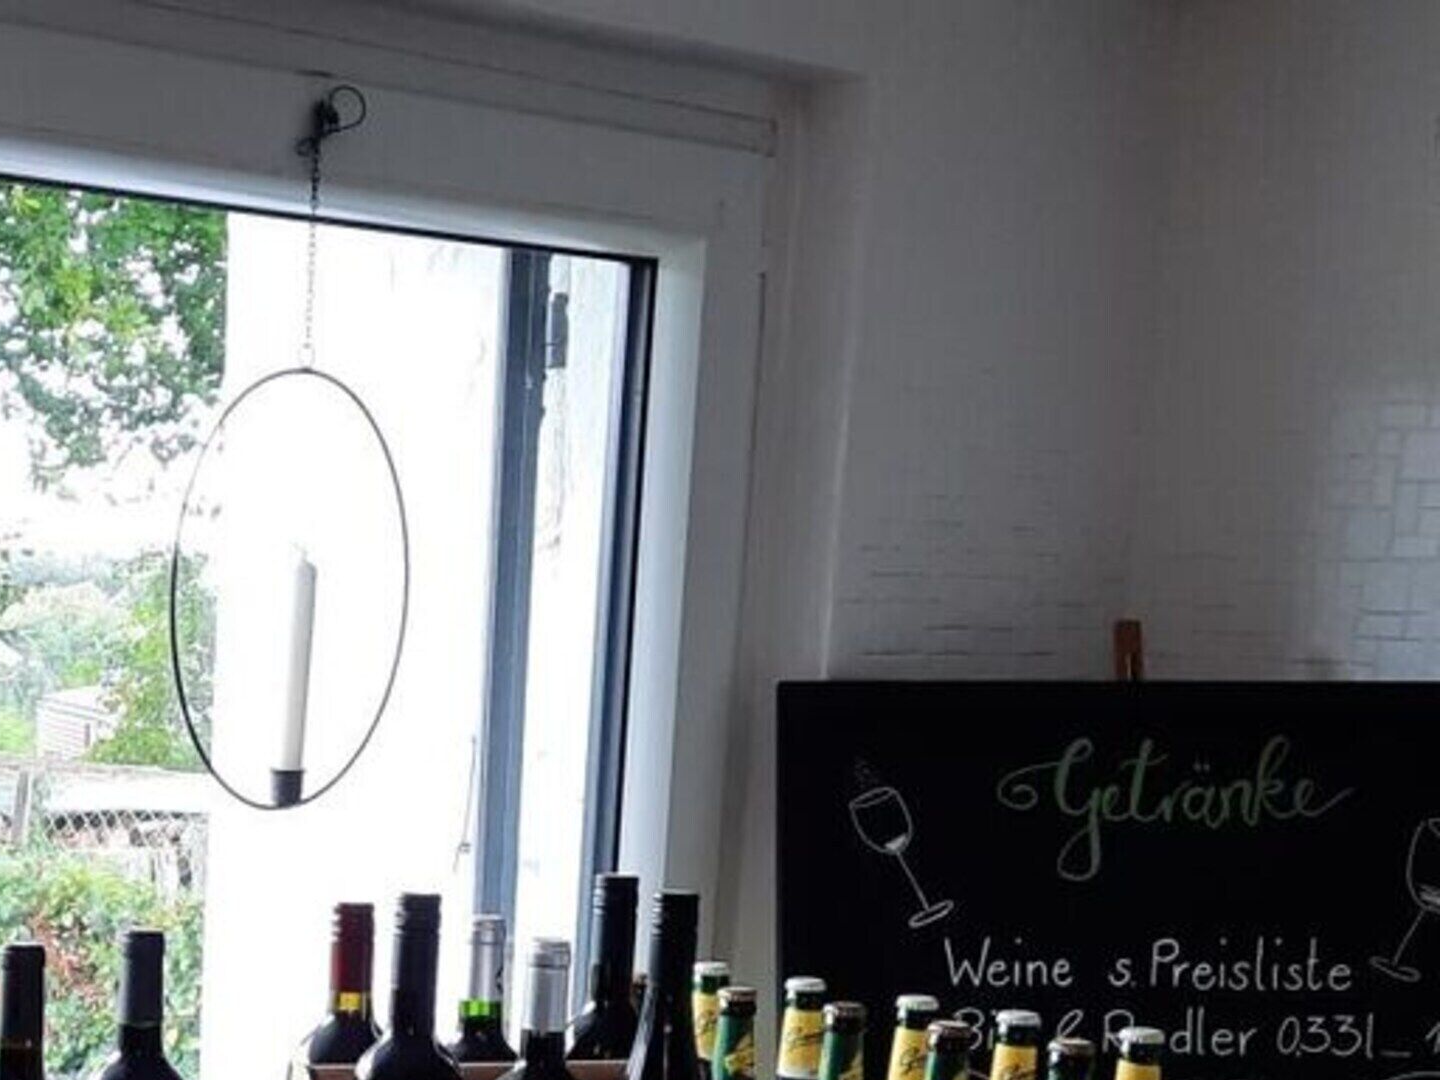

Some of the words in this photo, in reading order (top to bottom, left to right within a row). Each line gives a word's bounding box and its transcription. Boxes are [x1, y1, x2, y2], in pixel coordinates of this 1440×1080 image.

[996, 737, 1357, 881] Getränke
[944, 936, 1073, 987] Weine
[1102, 1006, 1258, 1057] Rdler
